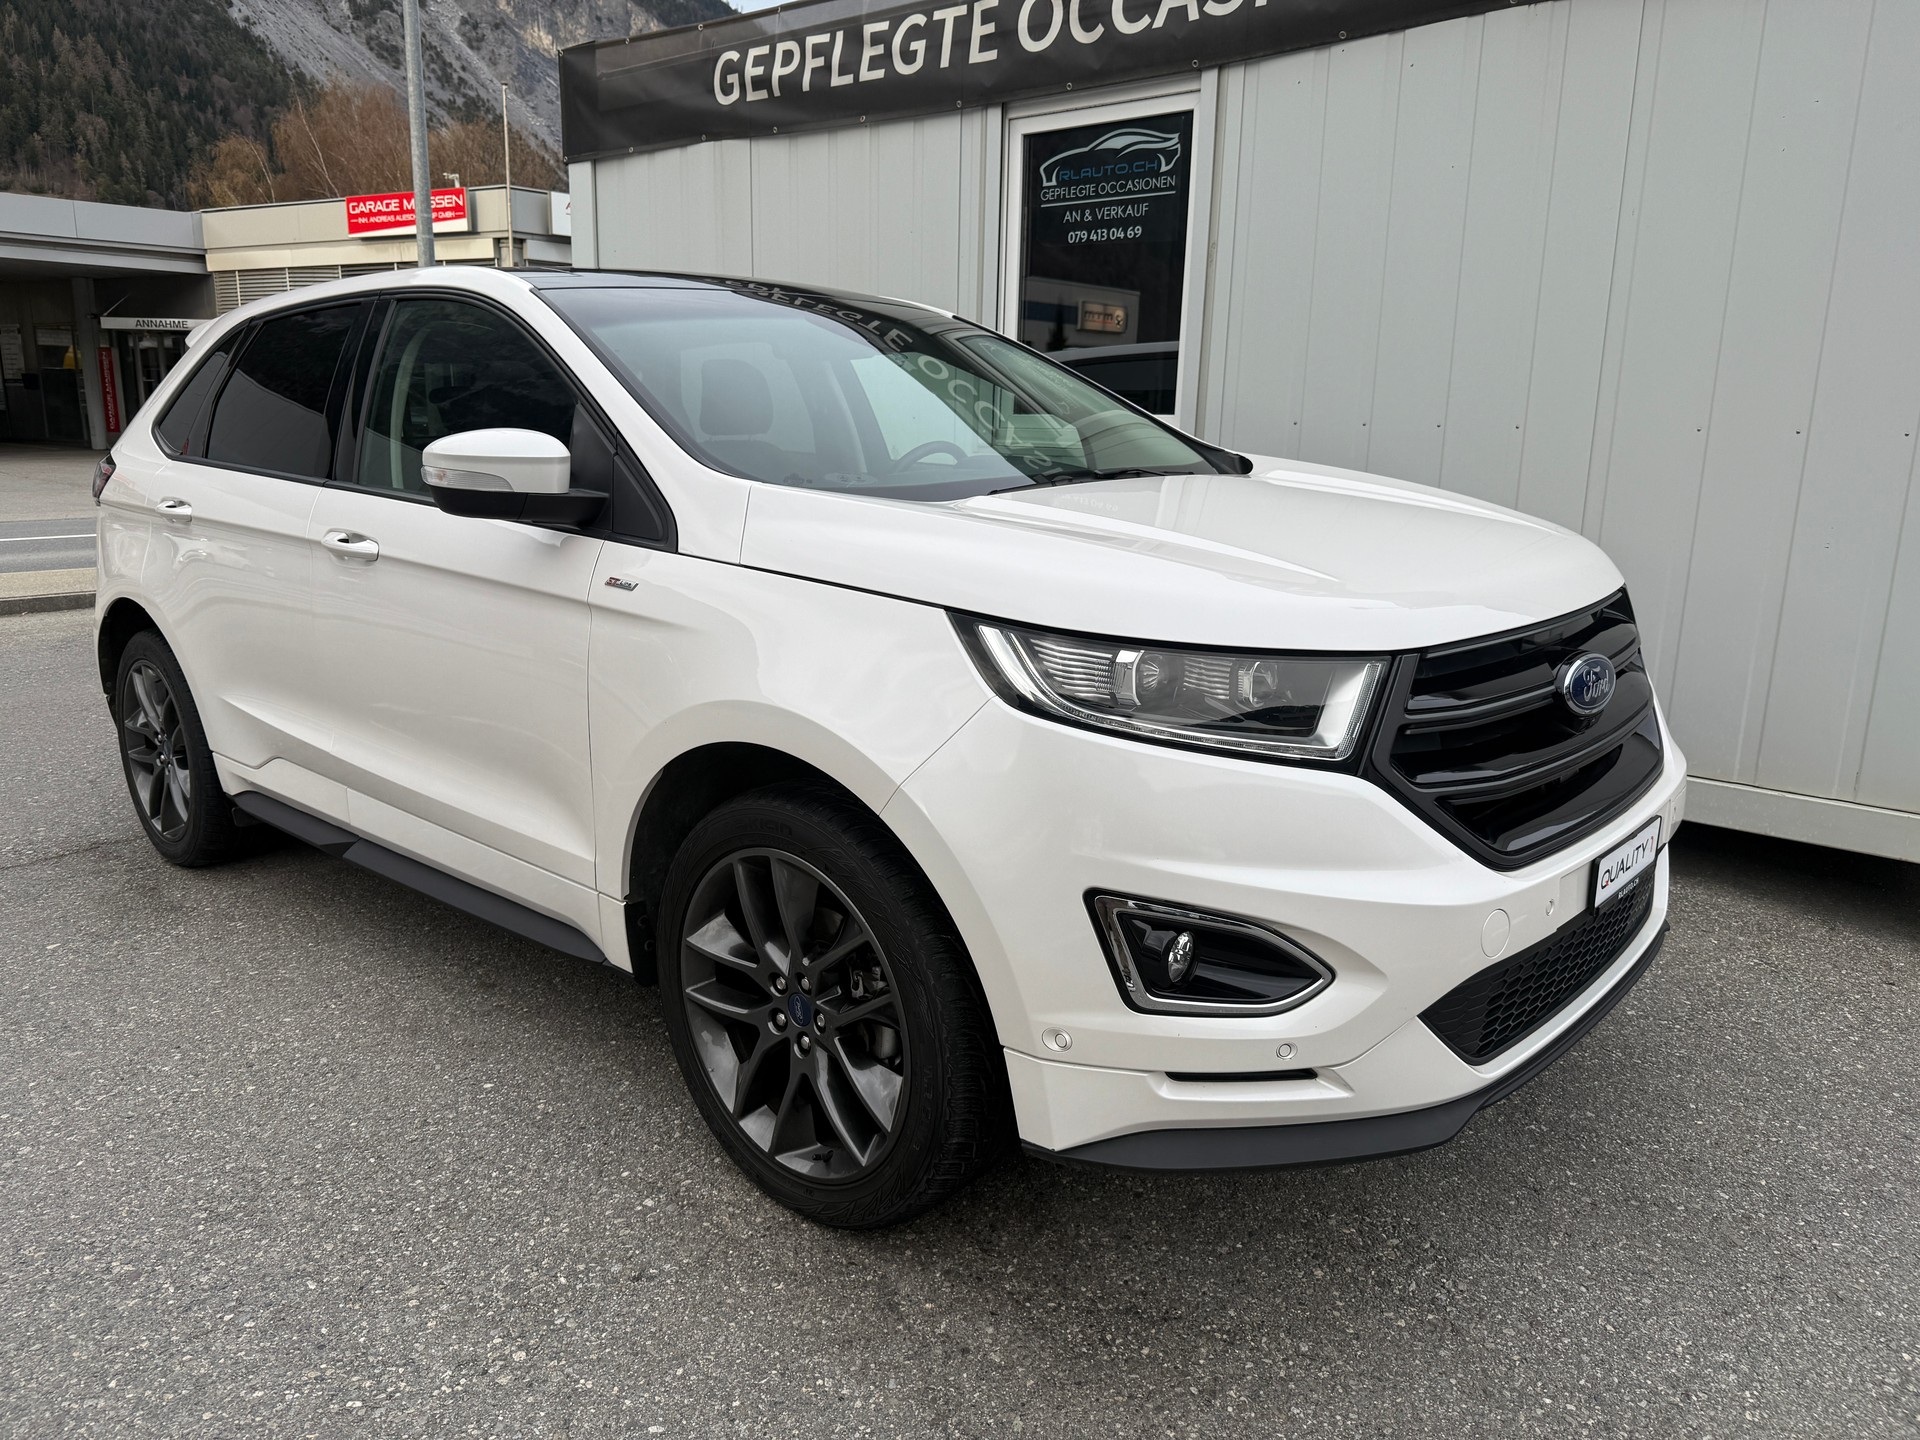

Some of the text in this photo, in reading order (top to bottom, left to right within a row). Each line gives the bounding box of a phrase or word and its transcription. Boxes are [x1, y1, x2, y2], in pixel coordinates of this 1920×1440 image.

[713, 1, 1000, 105] GEPFLEGTE
[1060, 161, 1158, 181] RLAUTO.CH
[1041, 175, 1176, 201] GEPFLEGTE OCCASIONEN
[348, 199, 400, 214] GARAGE
[1063, 203, 1149, 223] AN & VERKAUF
[1067, 225, 1142, 244] 079 413 04 69
[135, 319, 189, 329] ANNAHME
[1583, 666, 1610, 702] Ford
